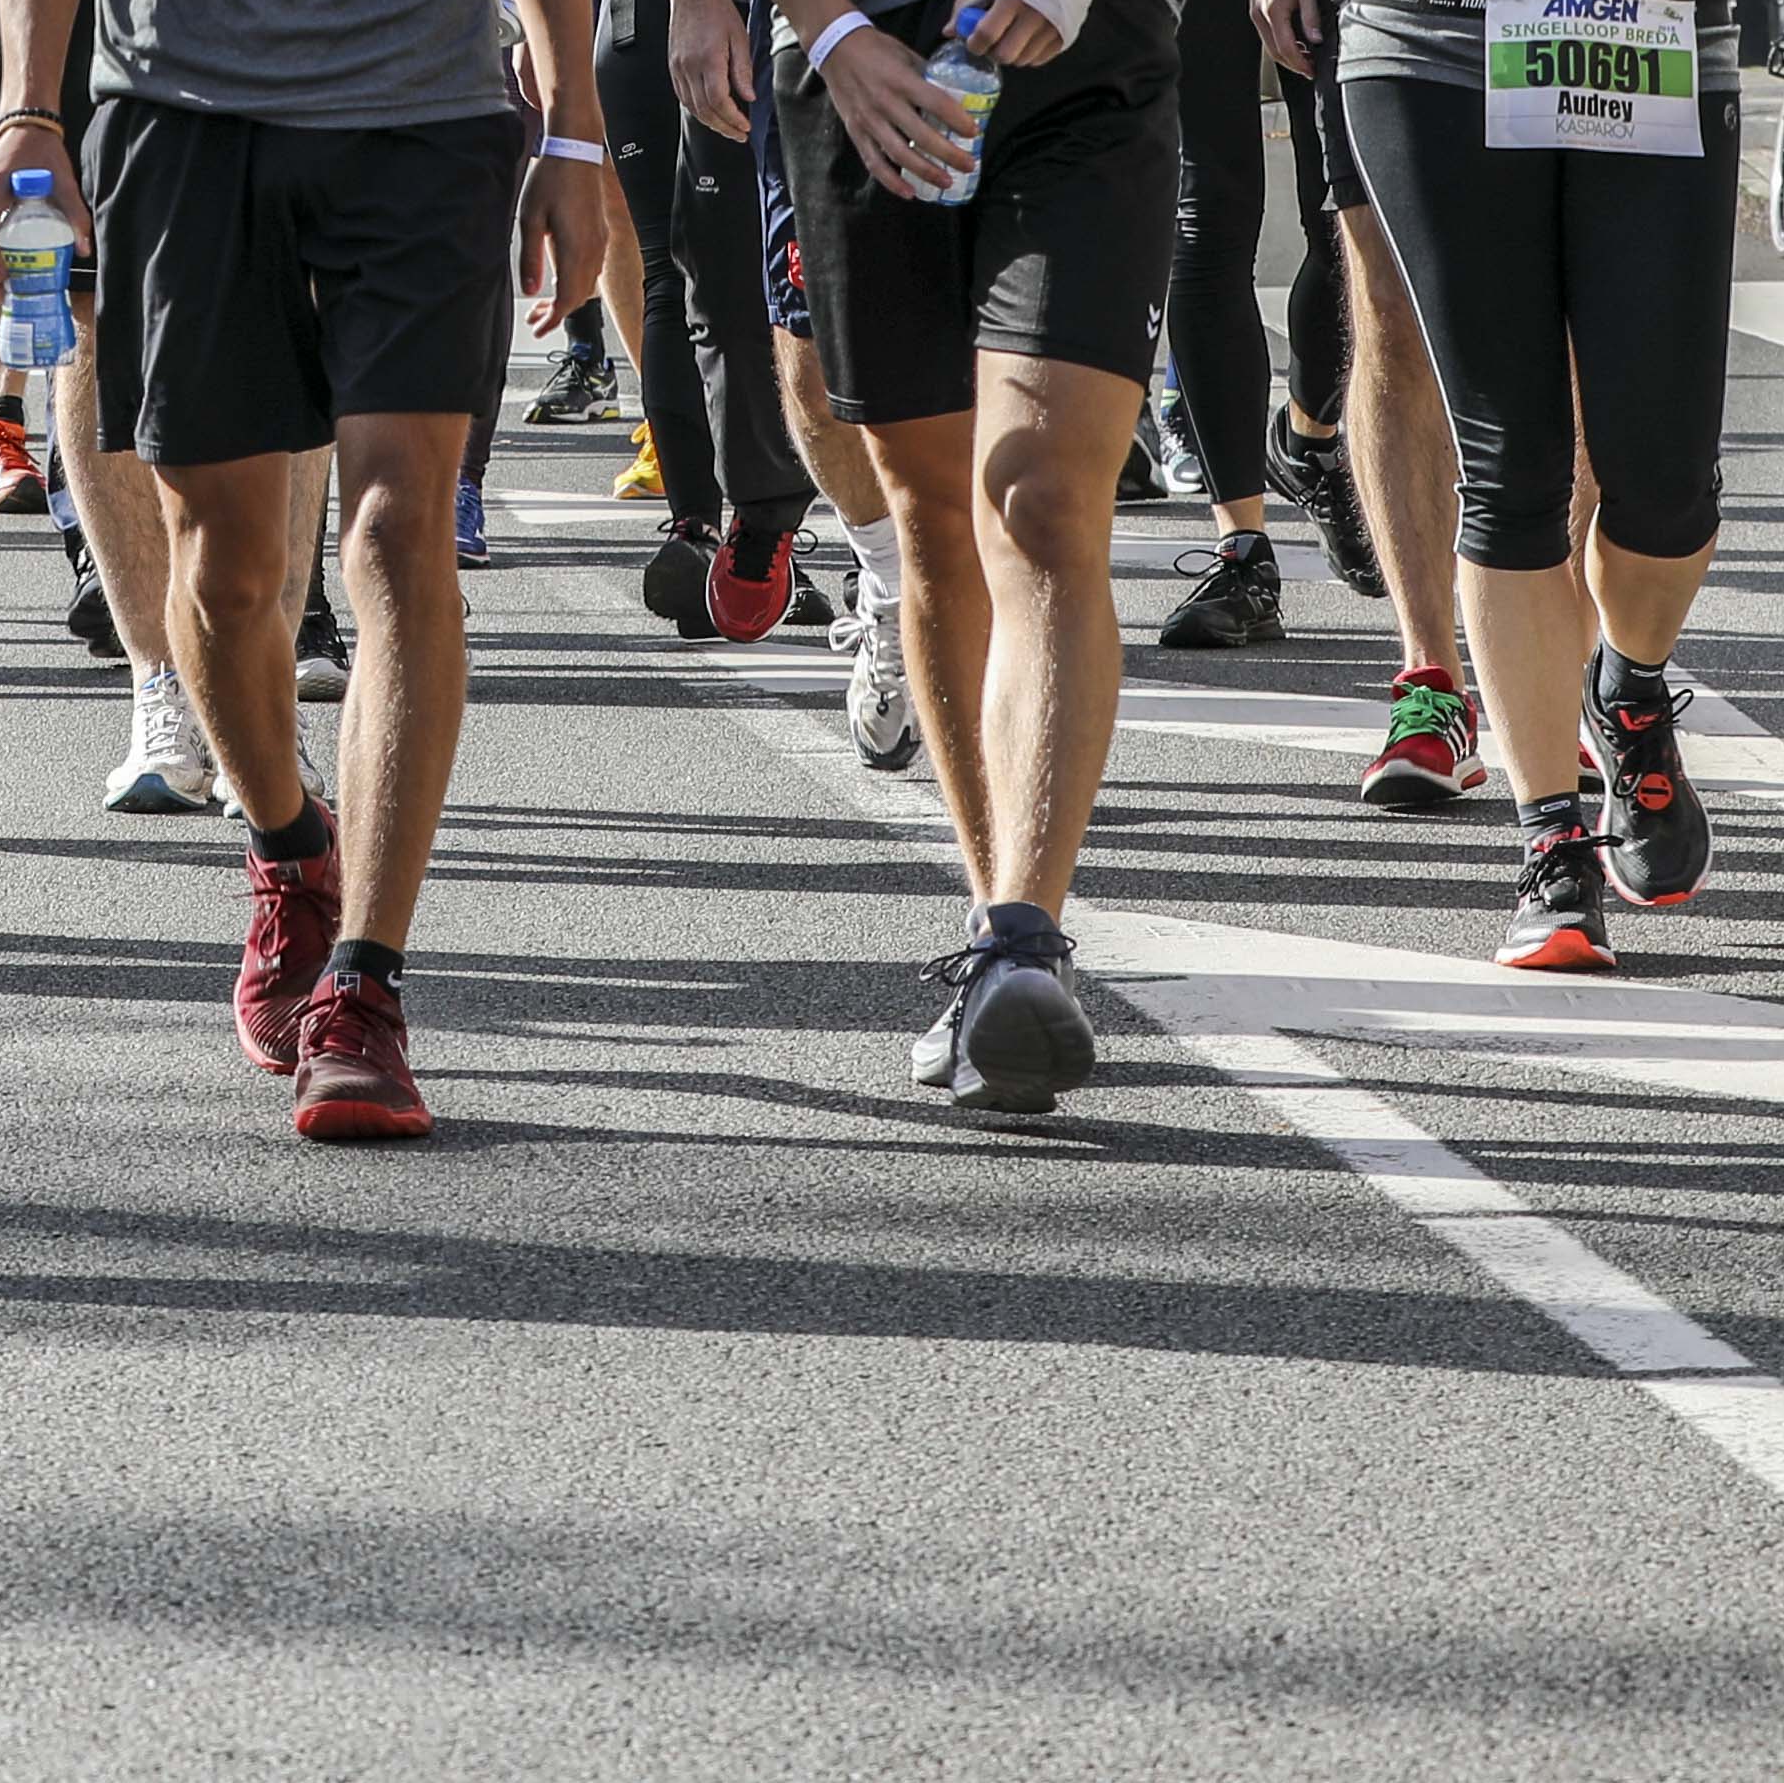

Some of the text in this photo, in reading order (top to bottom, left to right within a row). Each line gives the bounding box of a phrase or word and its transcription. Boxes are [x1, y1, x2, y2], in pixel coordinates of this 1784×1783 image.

[1501, 21, 1680, 45] SINGELLOOP BREDA
[1525, 40, 1660, 95] 50691
[1558, 91, 1633, 123] Audrey
[1555, 118, 1635, 139] KASPAROV
